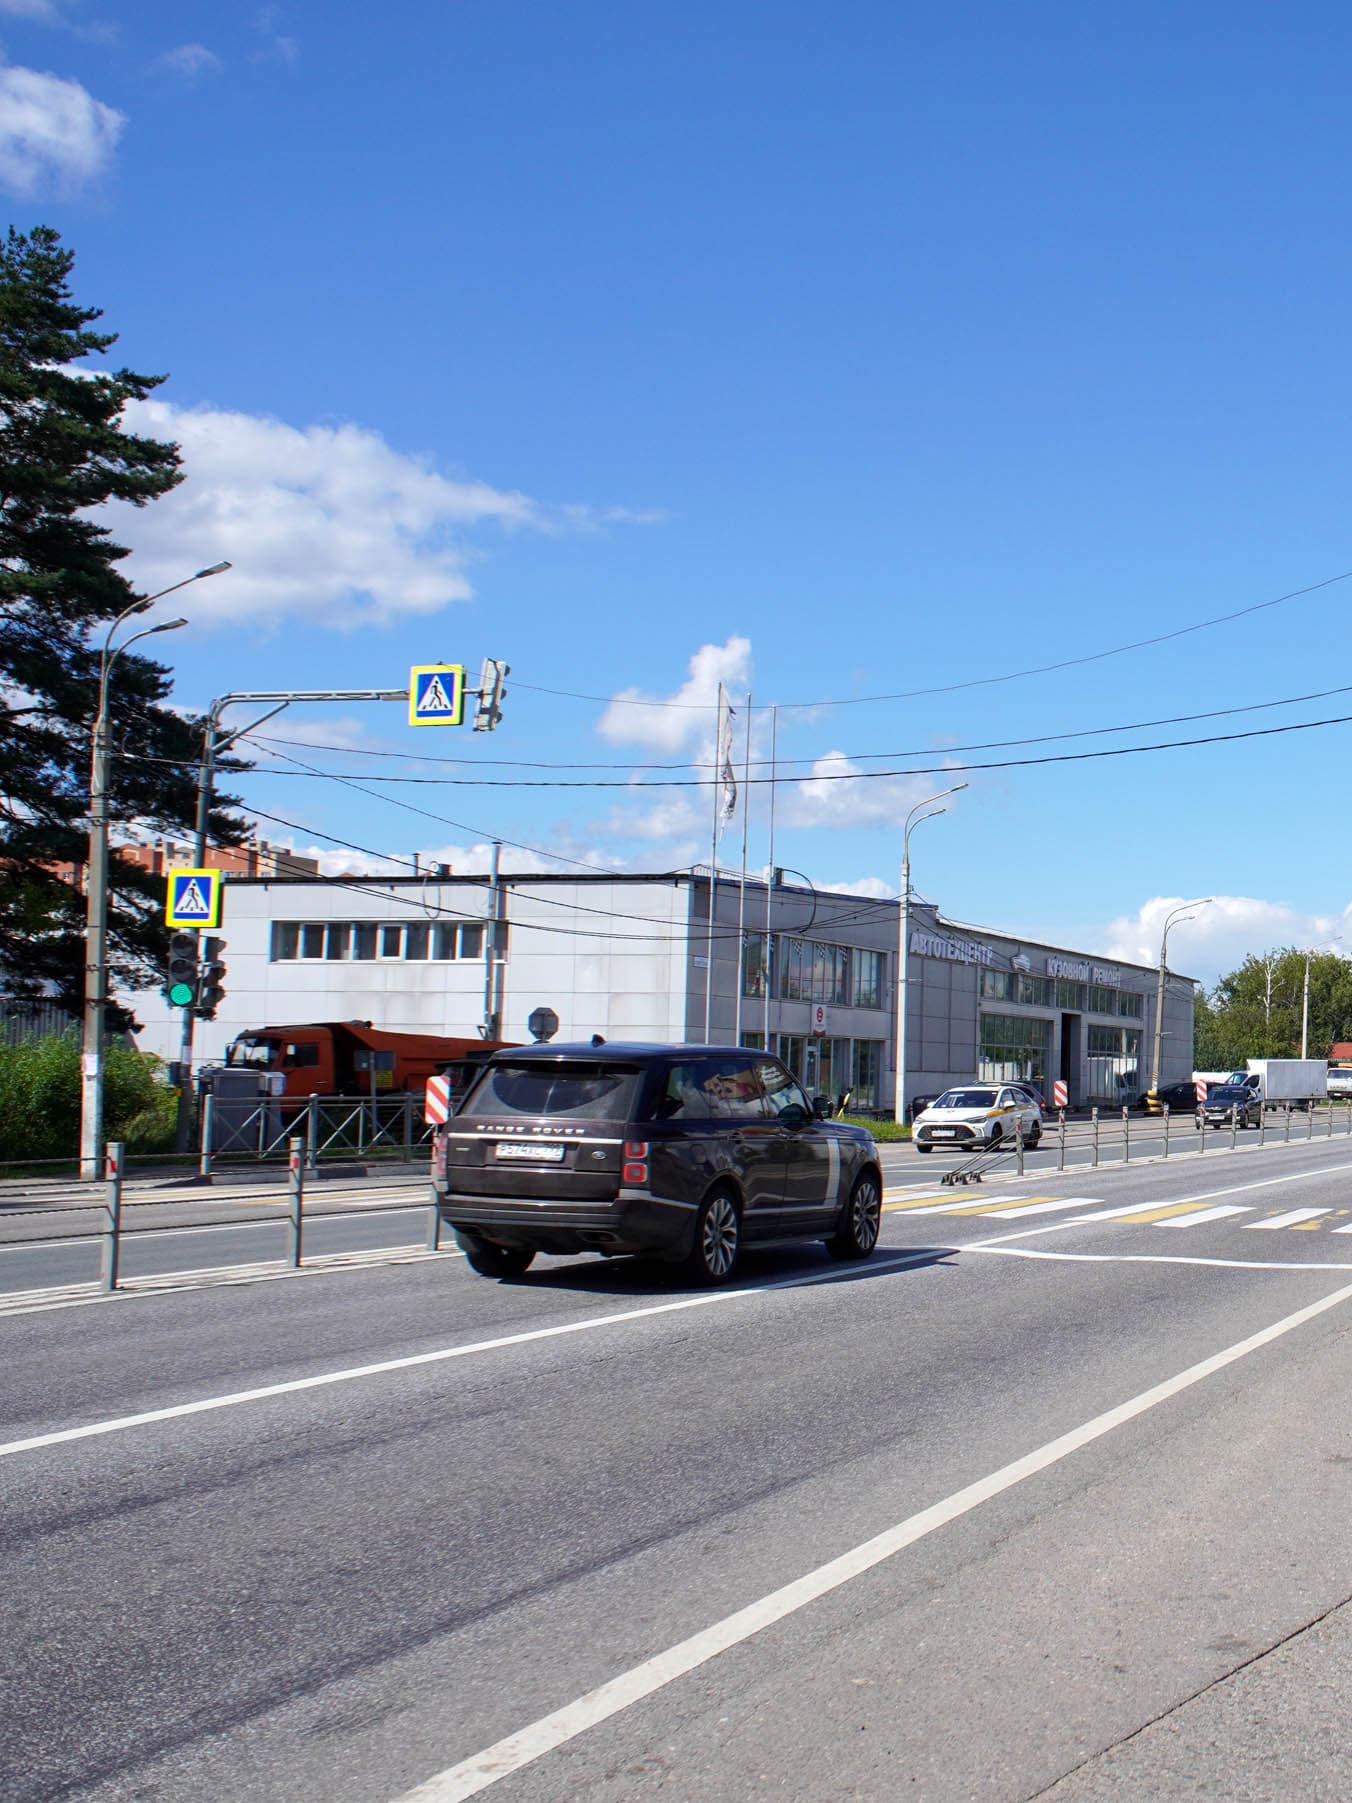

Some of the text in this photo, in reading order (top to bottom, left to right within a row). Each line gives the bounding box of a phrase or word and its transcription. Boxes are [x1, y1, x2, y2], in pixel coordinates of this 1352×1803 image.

[910, 932, 1121, 987] АВТОТЕХЦЕНТР КУЗОВНОЙ РЕМОНТ
[476, 1124, 585, 1135] RANGE ROVER
